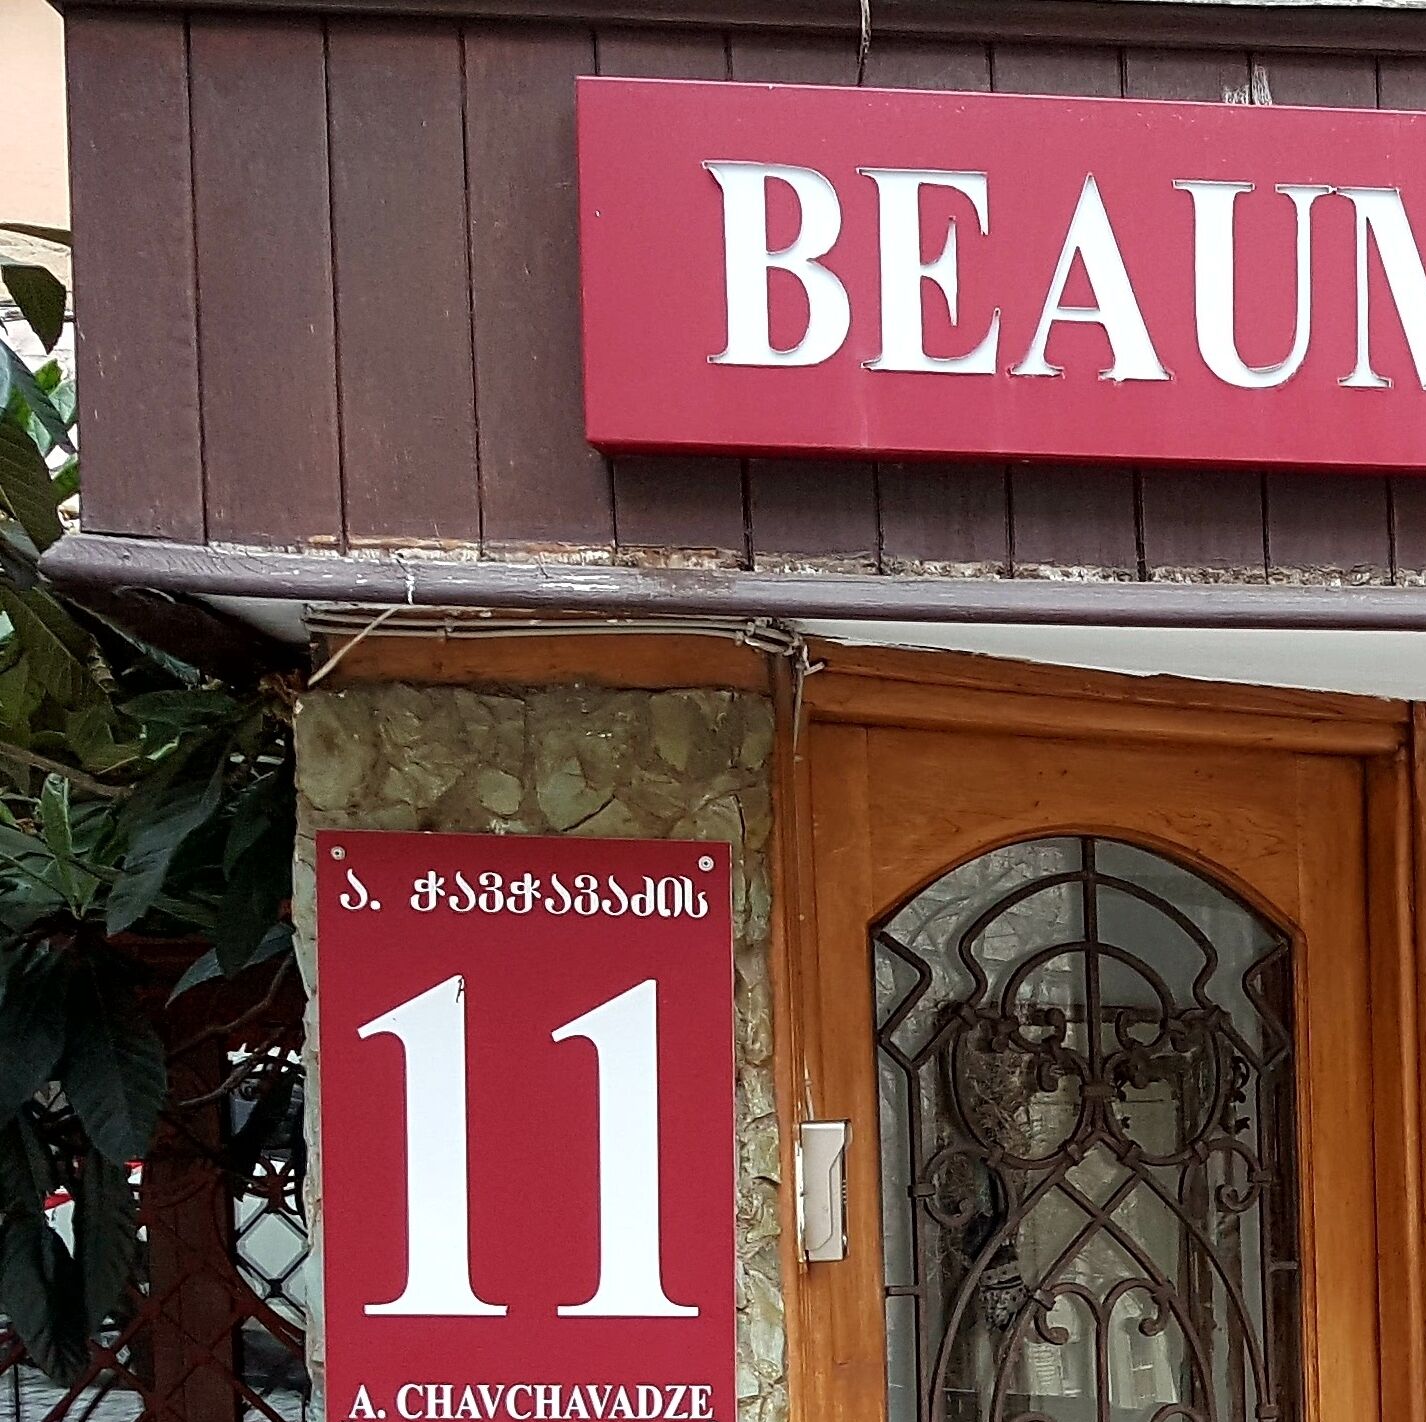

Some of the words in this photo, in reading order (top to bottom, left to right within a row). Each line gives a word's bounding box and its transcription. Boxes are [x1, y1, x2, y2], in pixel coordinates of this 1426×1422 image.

[339, 868, 381, 911] ა.
[410, 870, 709, 918] ჭავჭავაძის
[357, 974, 699, 1317] 11
[348, 1384, 386, 1420] A.
[396, 1383, 714, 1420] CHAVCHAVADZE
